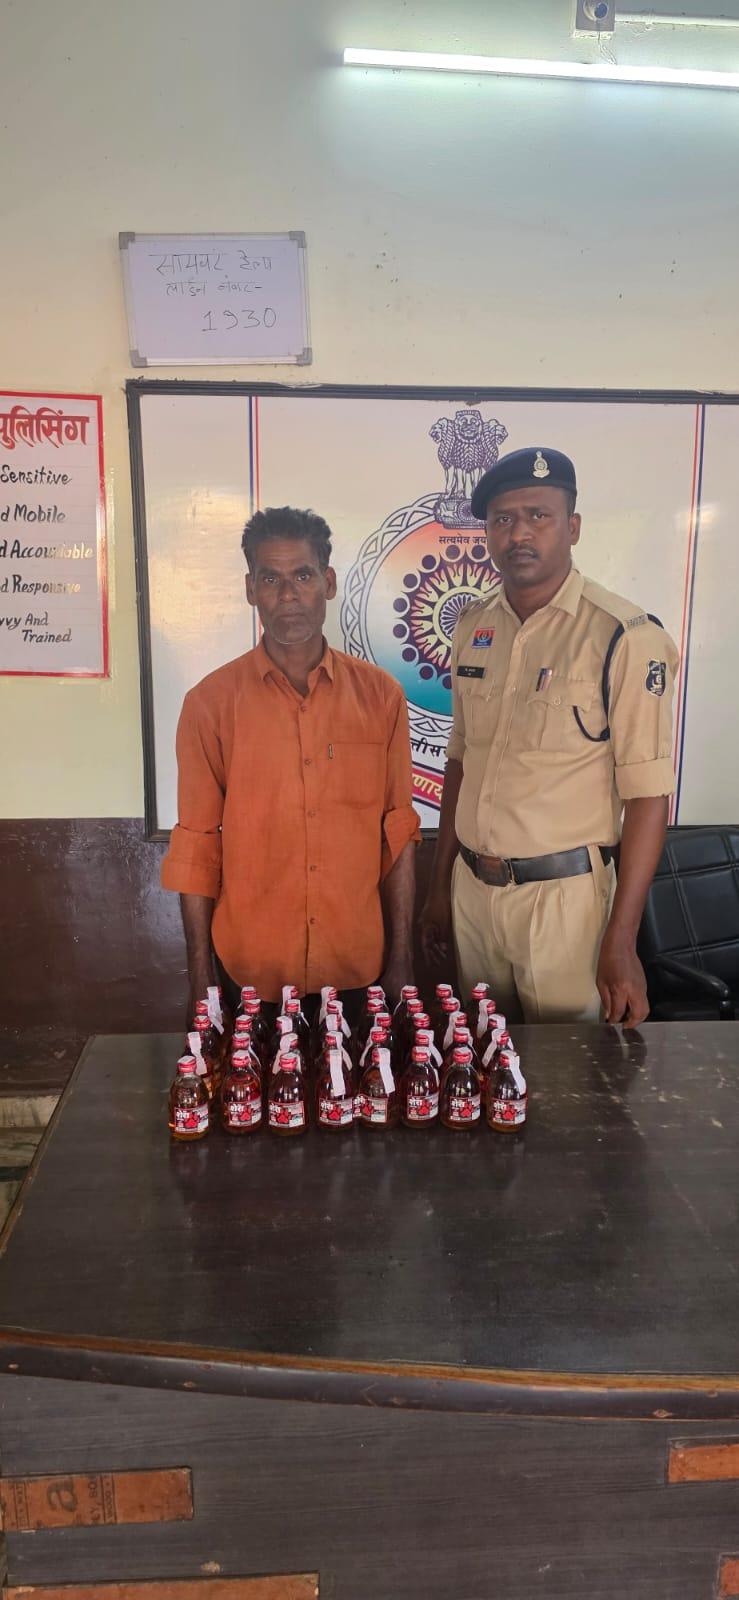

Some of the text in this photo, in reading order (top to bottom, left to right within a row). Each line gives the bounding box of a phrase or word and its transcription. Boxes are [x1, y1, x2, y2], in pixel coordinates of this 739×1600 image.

[201, 307, 277, 332] 1930
[0, 464, 72, 485] Sensitive
[14, 503, 66, 522] Mobile
[10, 539, 93, 559] Accoutable
[472, 535, 487, 545] जय
[0, 611, 49, 630] vvy And
[22, 628, 72, 643] Trained
